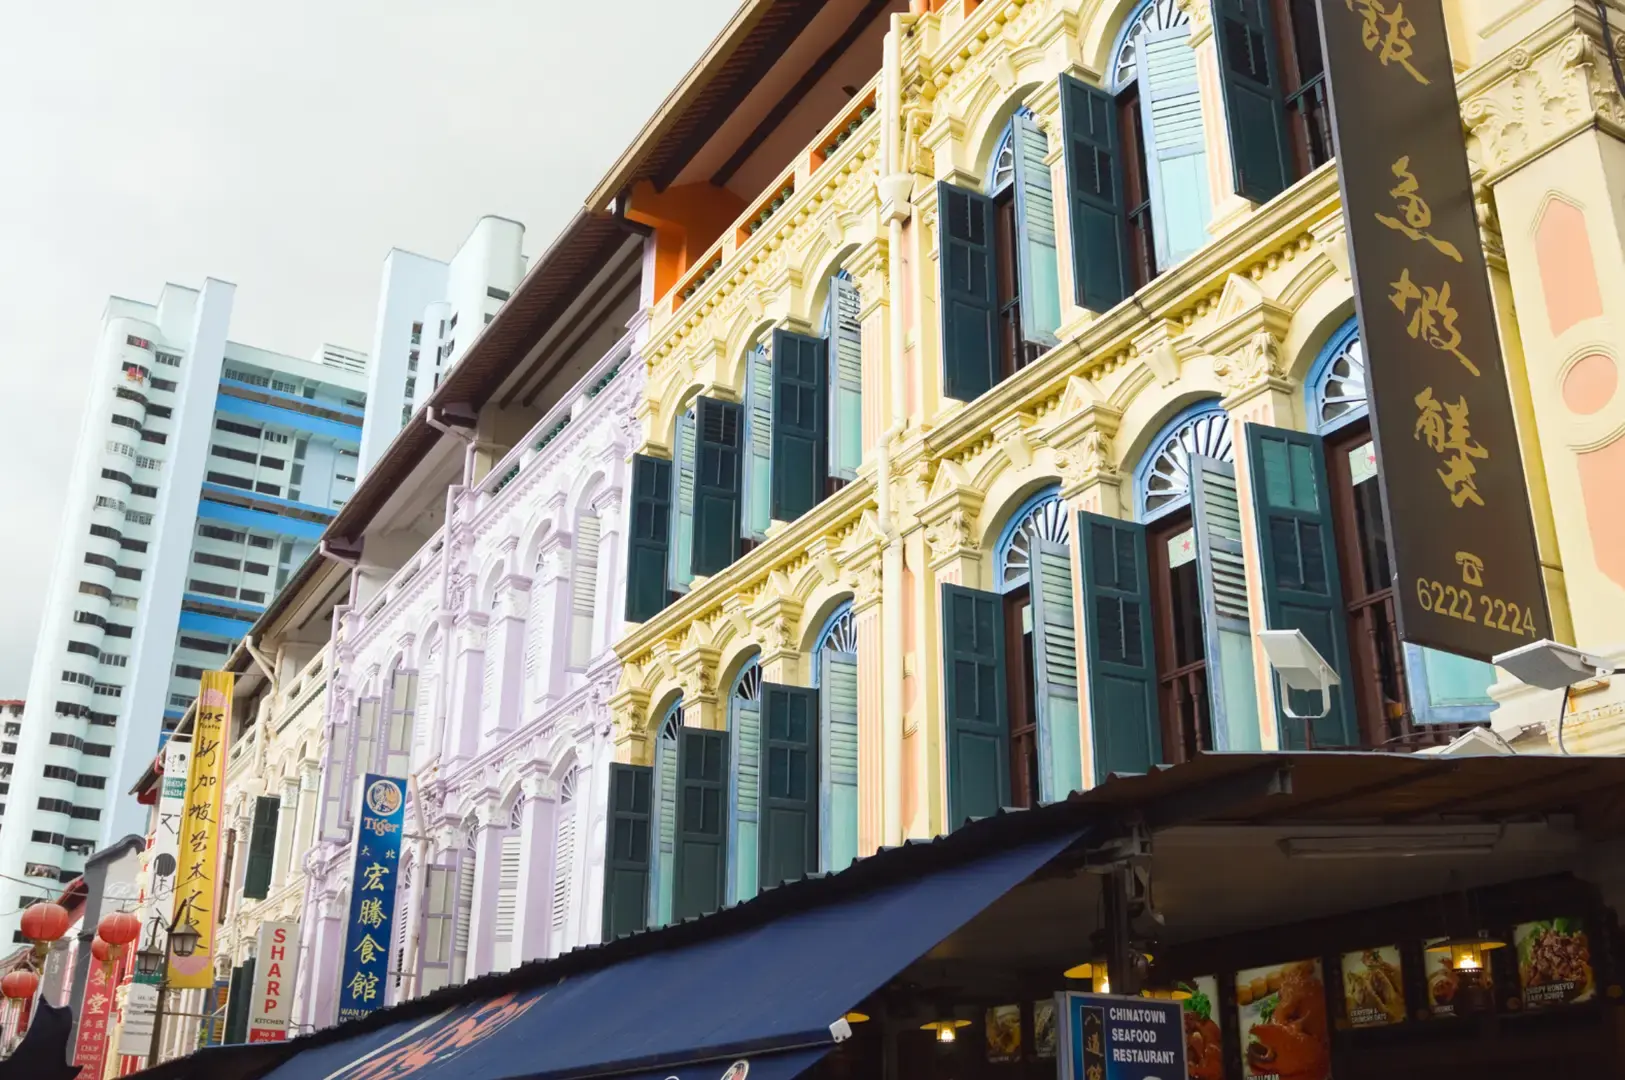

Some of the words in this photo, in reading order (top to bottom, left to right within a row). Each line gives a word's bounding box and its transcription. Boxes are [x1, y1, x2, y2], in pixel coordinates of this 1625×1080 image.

[1416, 577, 1476, 624] 6222
[1480, 594, 1537, 639] 2224
[364, 817, 399, 836] Tiger
[264, 928, 286, 1013] SHARP
[341, 1008, 359, 1016] WAN
[1109, 1007, 1166, 1023] CHINATOWN
[1112, 1028, 1157, 1043] SEAFOOD
[1112, 1048, 1175, 1064] RESTAURANT
